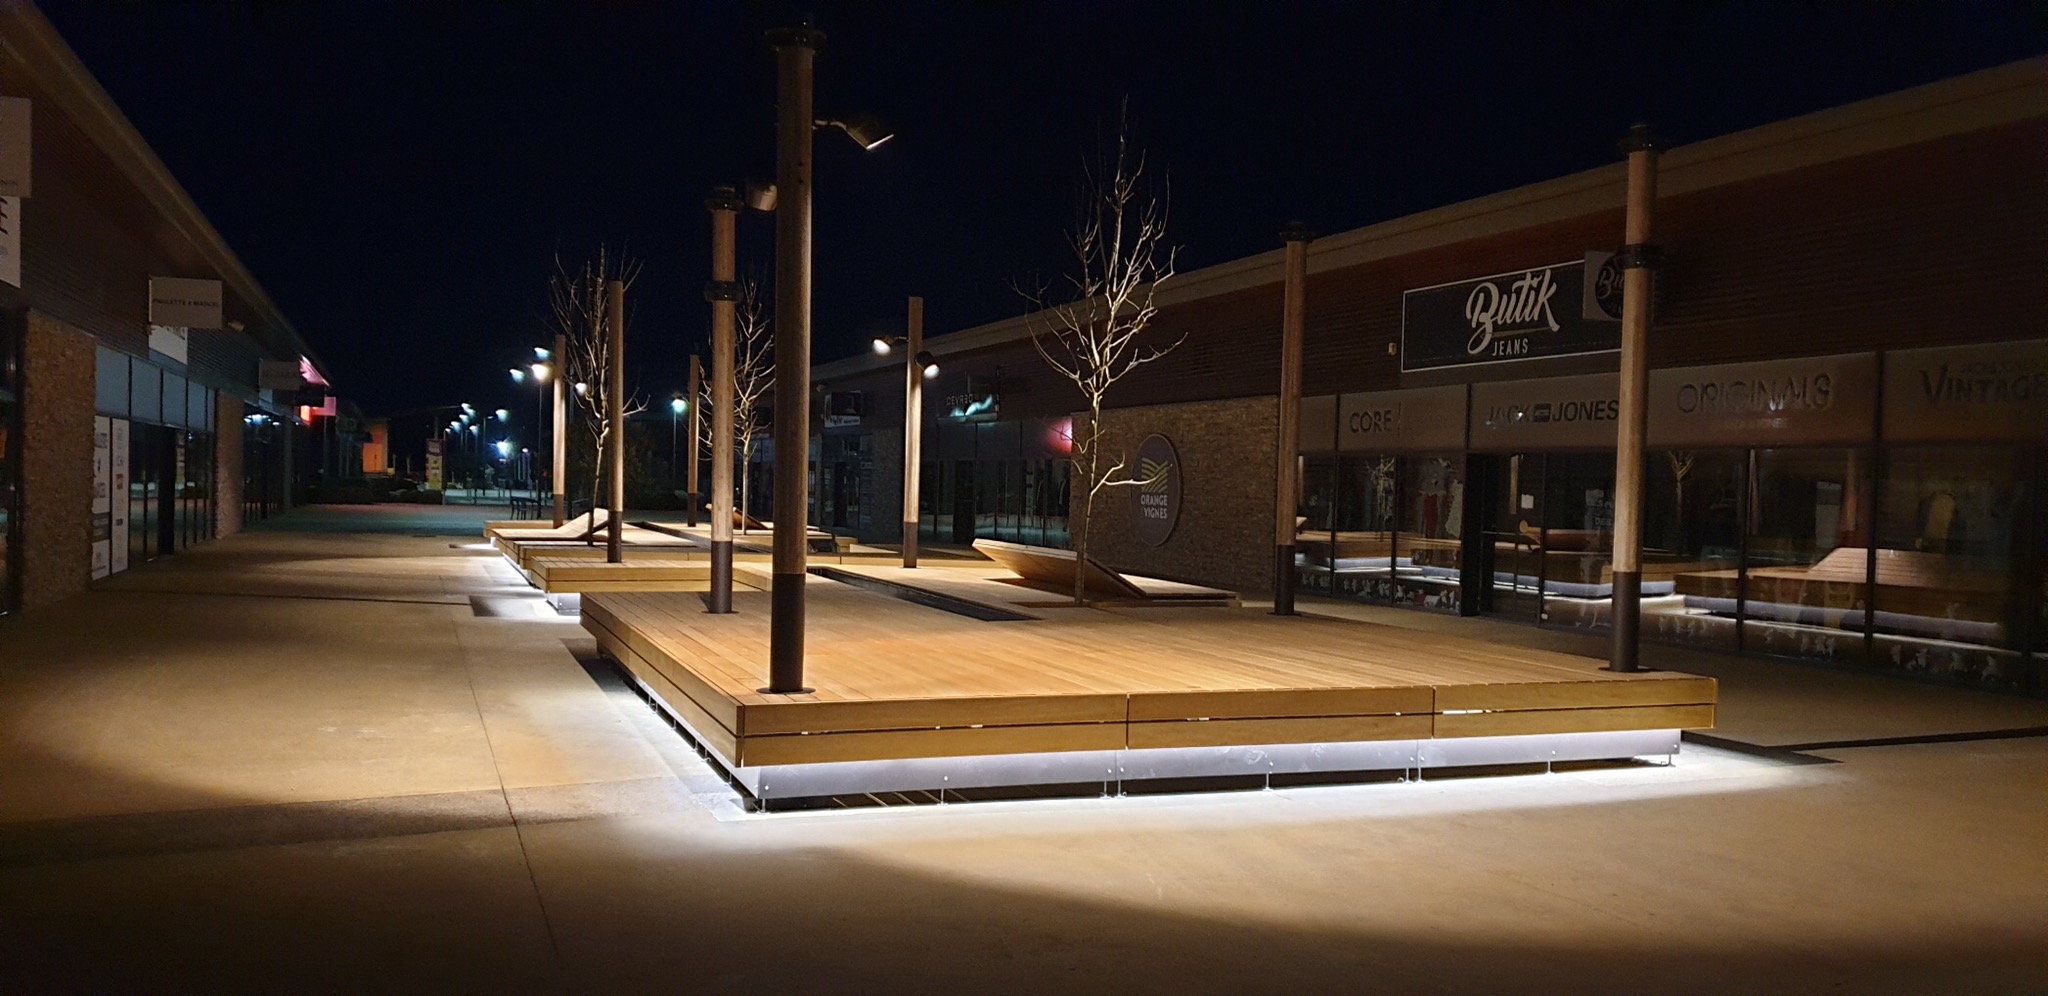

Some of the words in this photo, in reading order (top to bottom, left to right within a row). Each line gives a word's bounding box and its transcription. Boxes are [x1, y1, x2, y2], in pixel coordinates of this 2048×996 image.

[1465, 269, 1561, 355] Butik
[1491, 337, 1529, 357] JEANS
[1677, 373, 1832, 413] ORIGINALS
[1350, 410, 1392, 434] CORE
[1553, 400, 1619, 422] JONES
[1140, 493, 1168, 507] ORANGE
[1143, 507, 1168, 519] VIGNES
